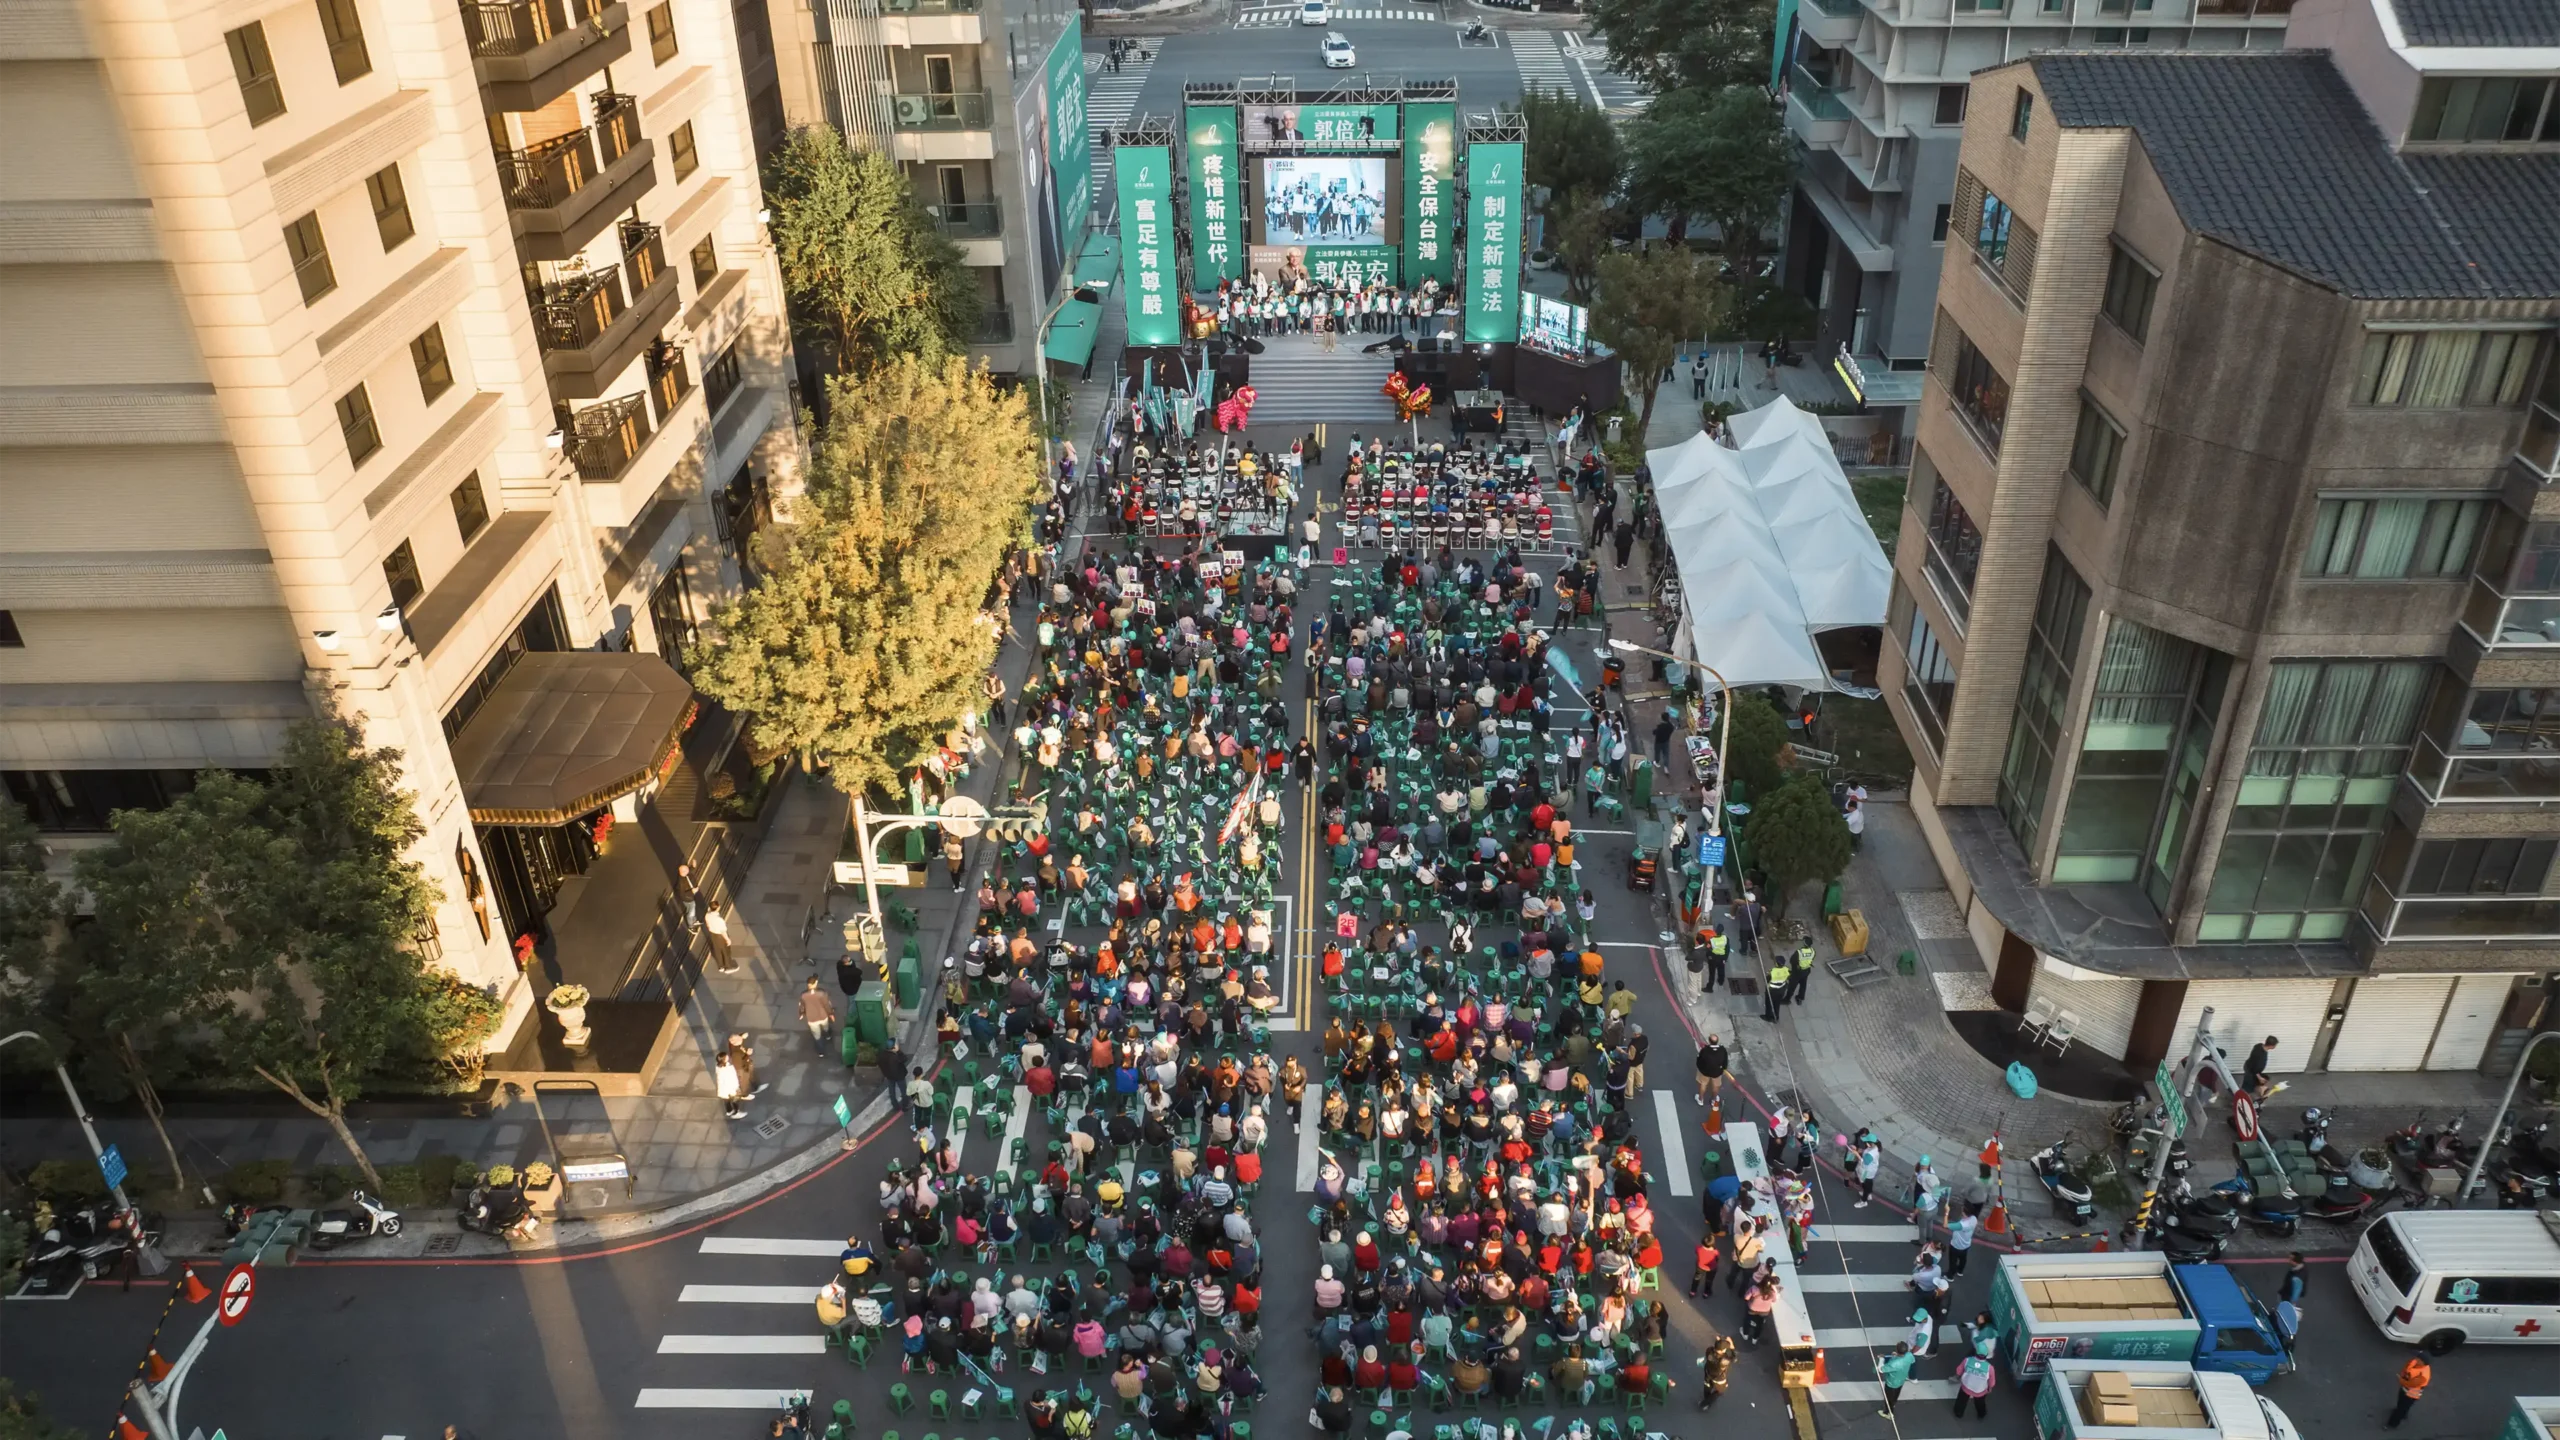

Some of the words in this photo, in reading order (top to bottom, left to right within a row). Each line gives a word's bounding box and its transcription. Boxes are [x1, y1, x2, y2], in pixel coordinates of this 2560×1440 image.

[1202, 153, 1229, 264] 疼惜新世代
[1418, 152, 1439, 261] 安全保台灣
[1134, 198, 1163, 315] 富足有尊嚴
[1482, 195, 1506, 313] 制定新憲法
[1315, 259, 1389, 285] 郭倍宏
[1276, 547, 1287, 556] 1A
[1703, 837, 1711, 846] P
[1340, 918, 1355, 928] 2B
[100, 1156, 107, 1169] P
[2111, 1342, 2170, 1356] 郭倍宏
